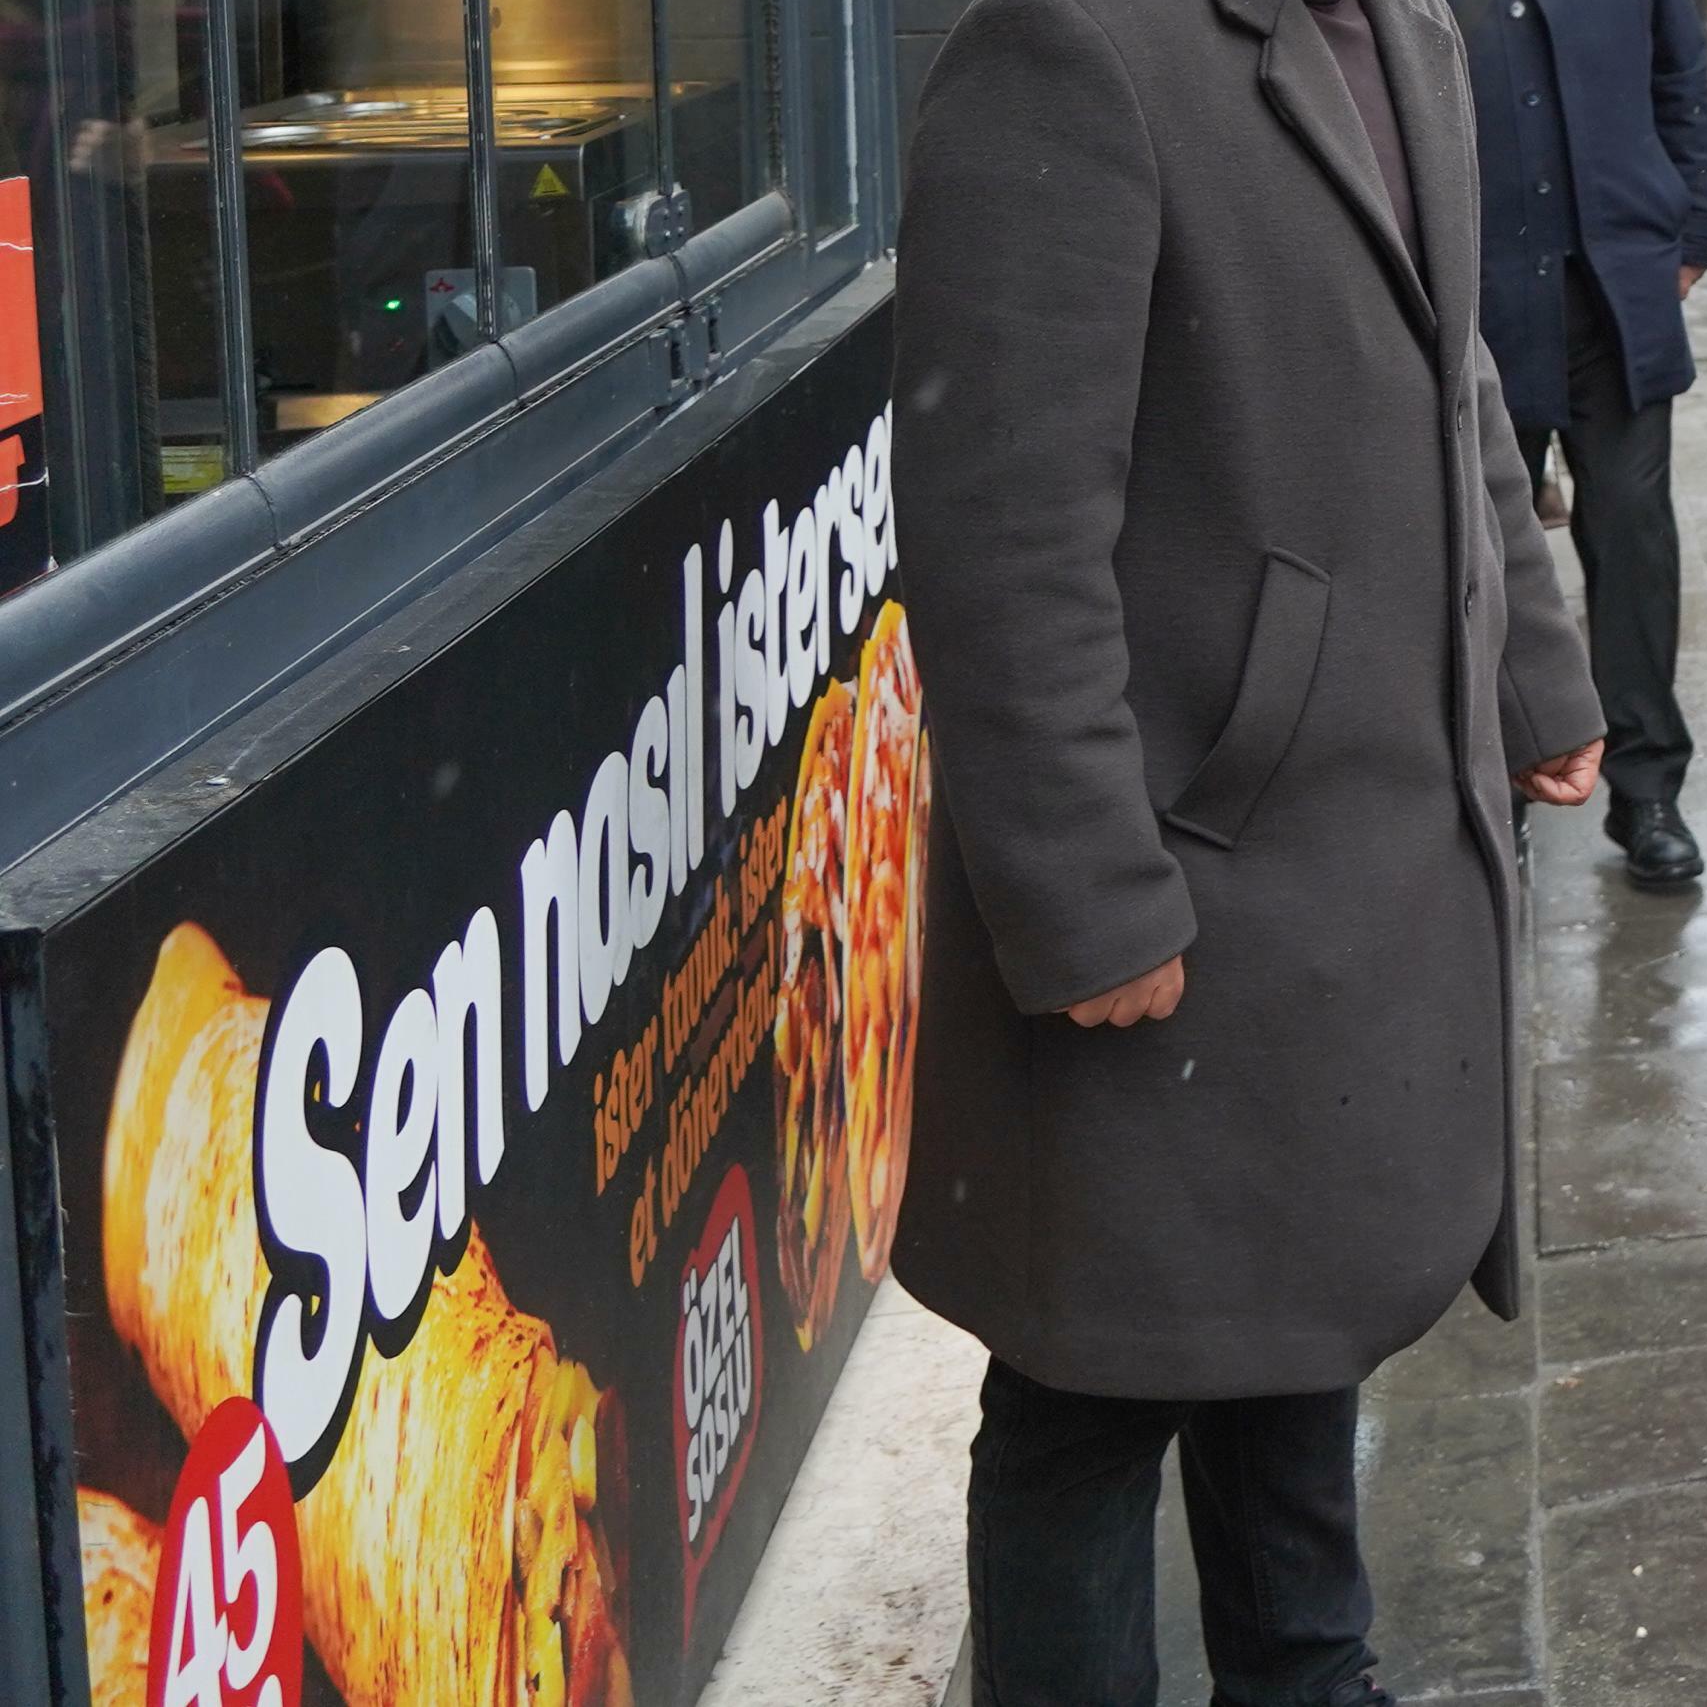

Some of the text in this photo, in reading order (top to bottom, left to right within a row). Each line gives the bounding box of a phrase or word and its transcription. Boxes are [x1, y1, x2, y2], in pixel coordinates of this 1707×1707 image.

[258, 906, 505, 1464] Sen
[520, 541, 705, 1114] nasıl
[593, 794, 789, 1198] ister tavuk, ister
[629, 918, 778, 1289] et dönerden!
[681, 1214, 748, 1429] ÖZEL
[685, 1312, 752, 1543] SOSLU
[163, 1421, 279, 1707] 45
